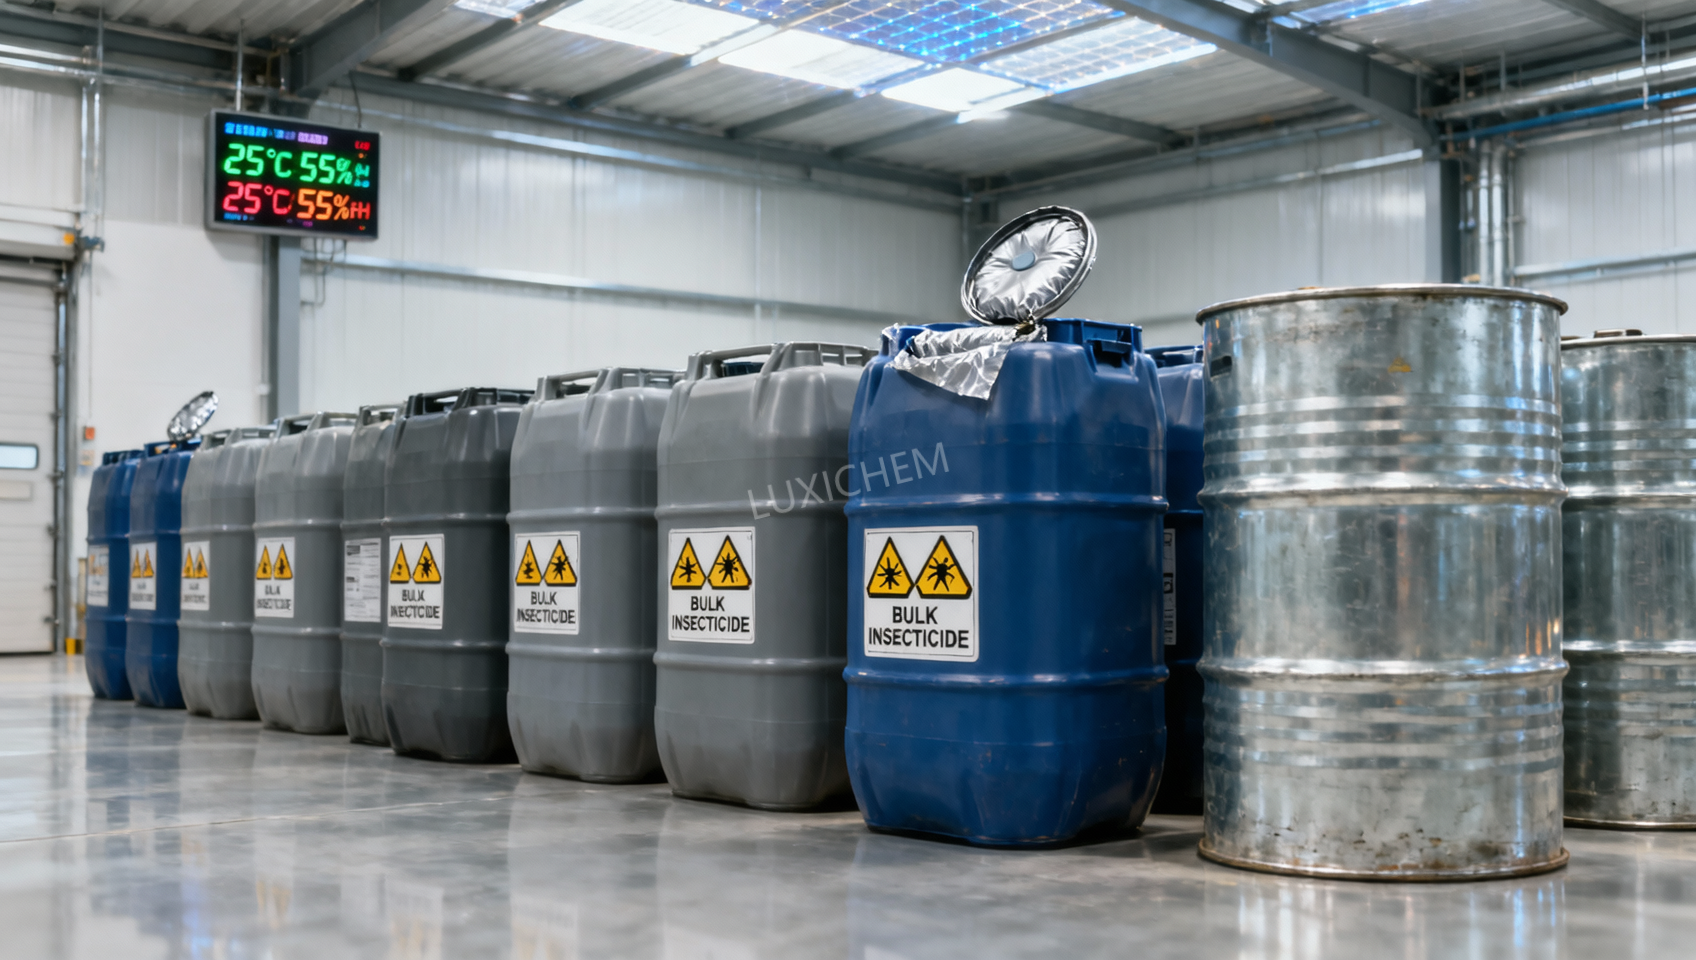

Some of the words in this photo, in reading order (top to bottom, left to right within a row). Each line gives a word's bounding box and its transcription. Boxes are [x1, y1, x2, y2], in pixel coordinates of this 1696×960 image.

[223, 143, 293, 178] 25°C
[222, 181, 291, 215] 25°C
[531, 591, 557, 605] BULK
[691, 595, 725, 612] BULK
[672, 614, 750, 633] INSECTICIDE
[892, 606, 938, 625] BULK
[868, 627, 970, 649] INSECTICIDE
